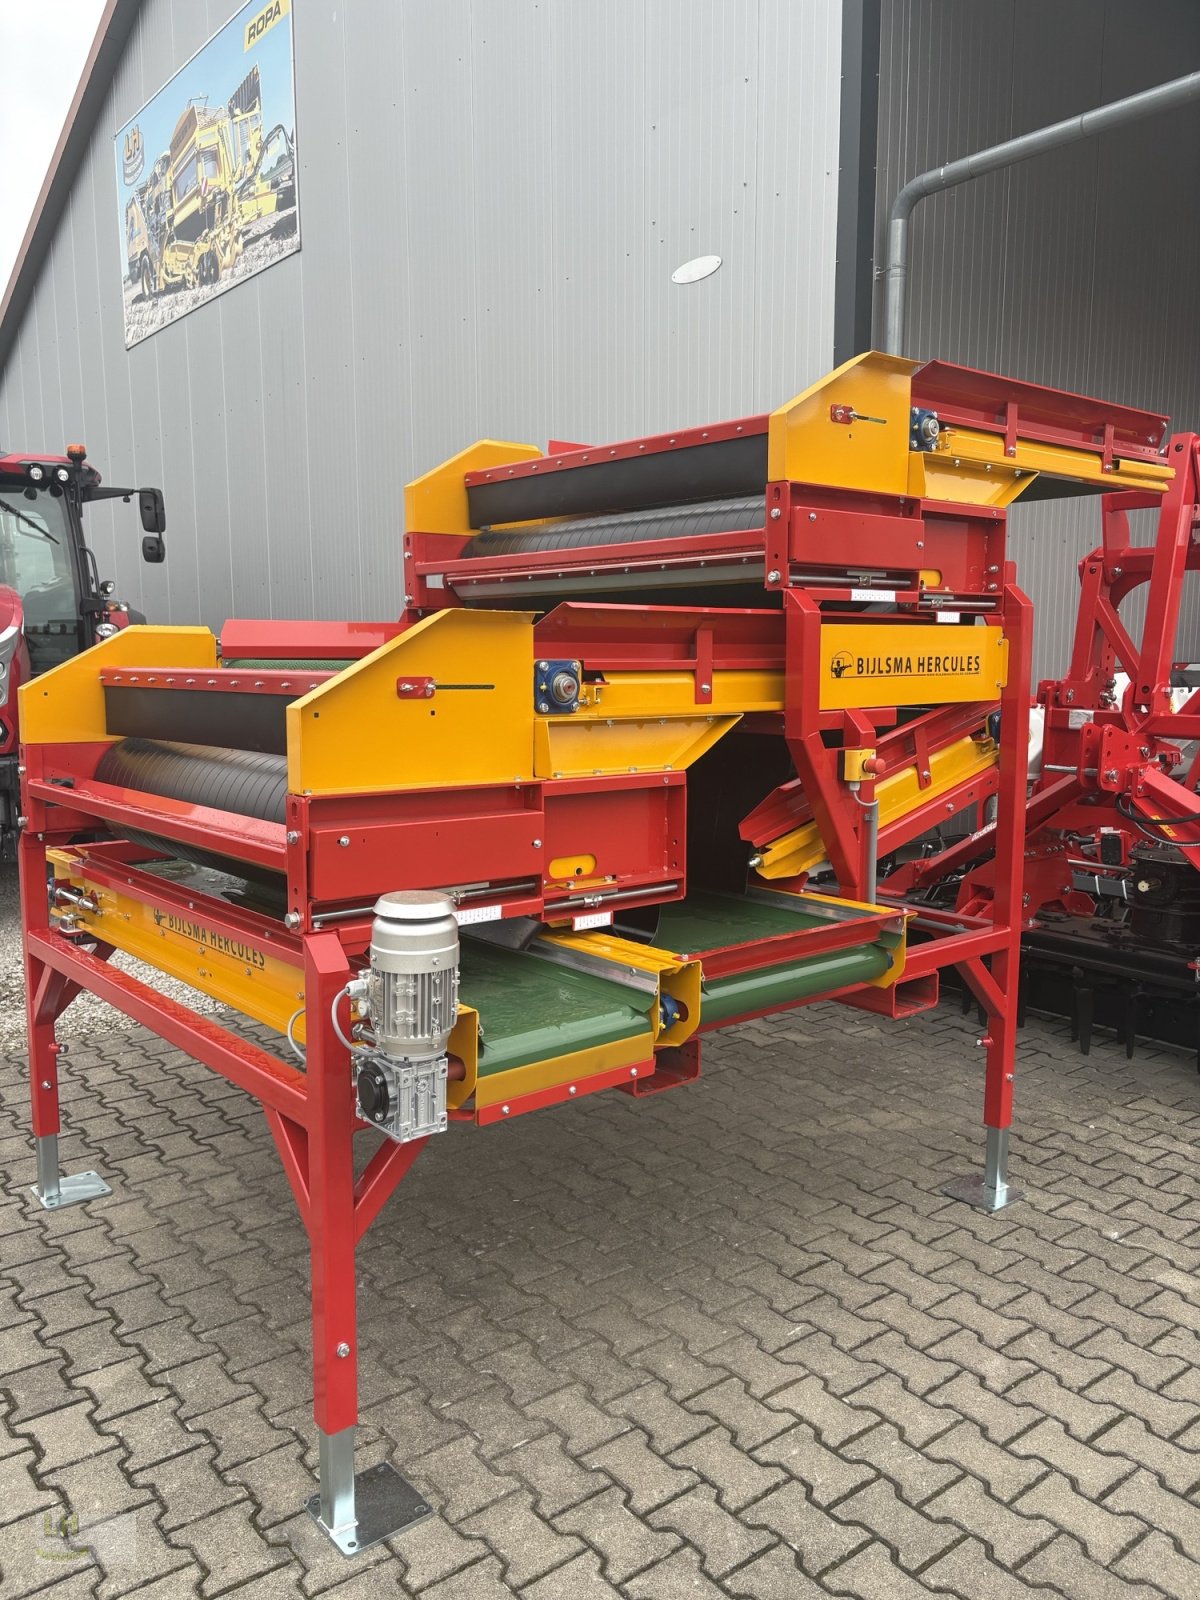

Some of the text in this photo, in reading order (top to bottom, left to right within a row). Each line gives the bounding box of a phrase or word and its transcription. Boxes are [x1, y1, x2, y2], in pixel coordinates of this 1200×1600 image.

[247, 0, 281, 45] ROPA
[124, 124, 140, 161] LH
[856, 656, 981, 675] BIJLSMA HERCULES
[168, 913, 265, 967] BIJLSMA HERCULES
